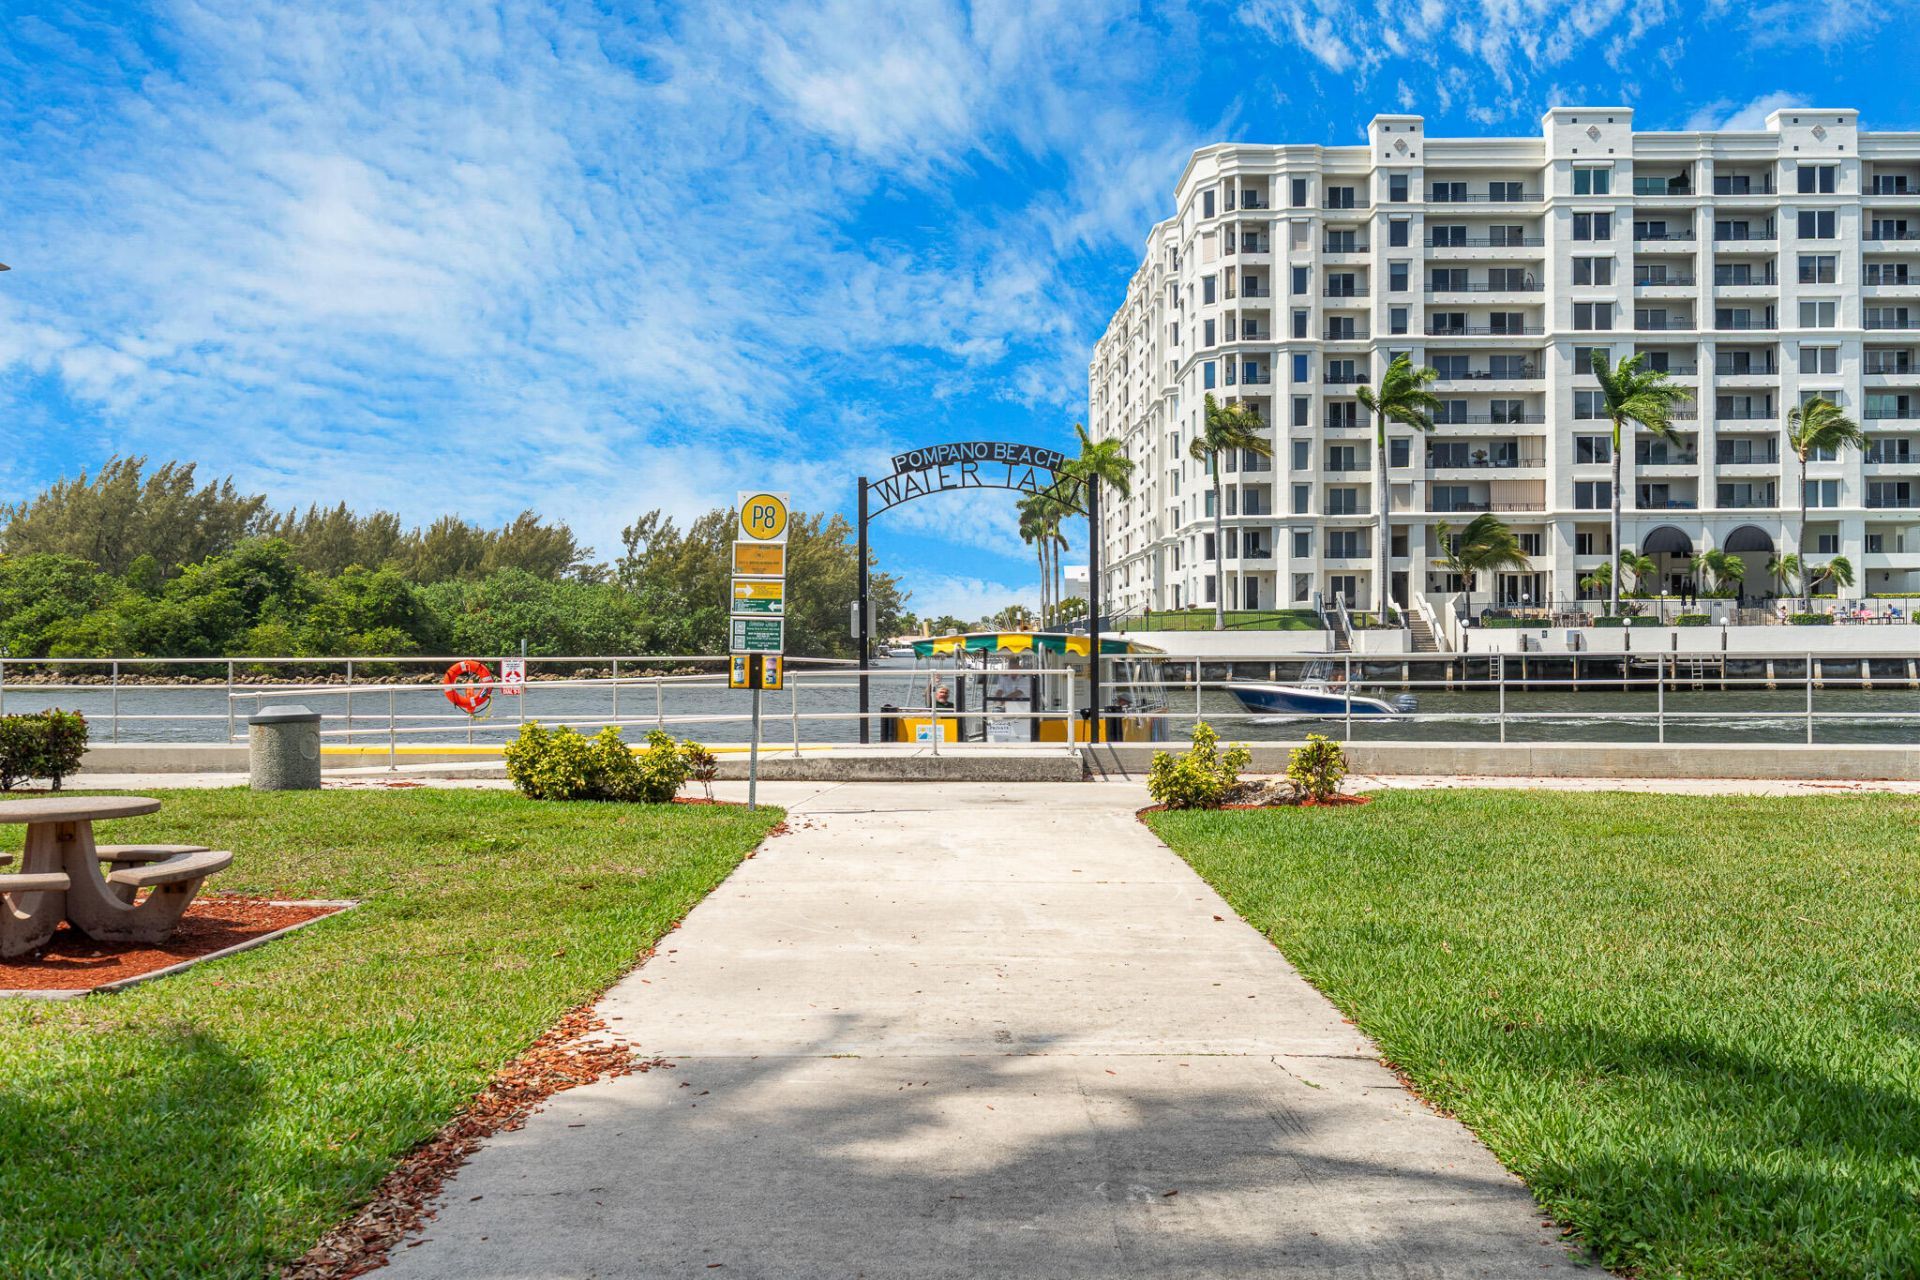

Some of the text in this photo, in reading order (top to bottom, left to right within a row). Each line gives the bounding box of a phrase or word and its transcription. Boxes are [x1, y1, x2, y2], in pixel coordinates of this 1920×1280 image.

[894, 442, 1062, 473] POMPANO BEACH
[874, 460, 1082, 506] WATER TAXI
[752, 505, 776, 529] P8
